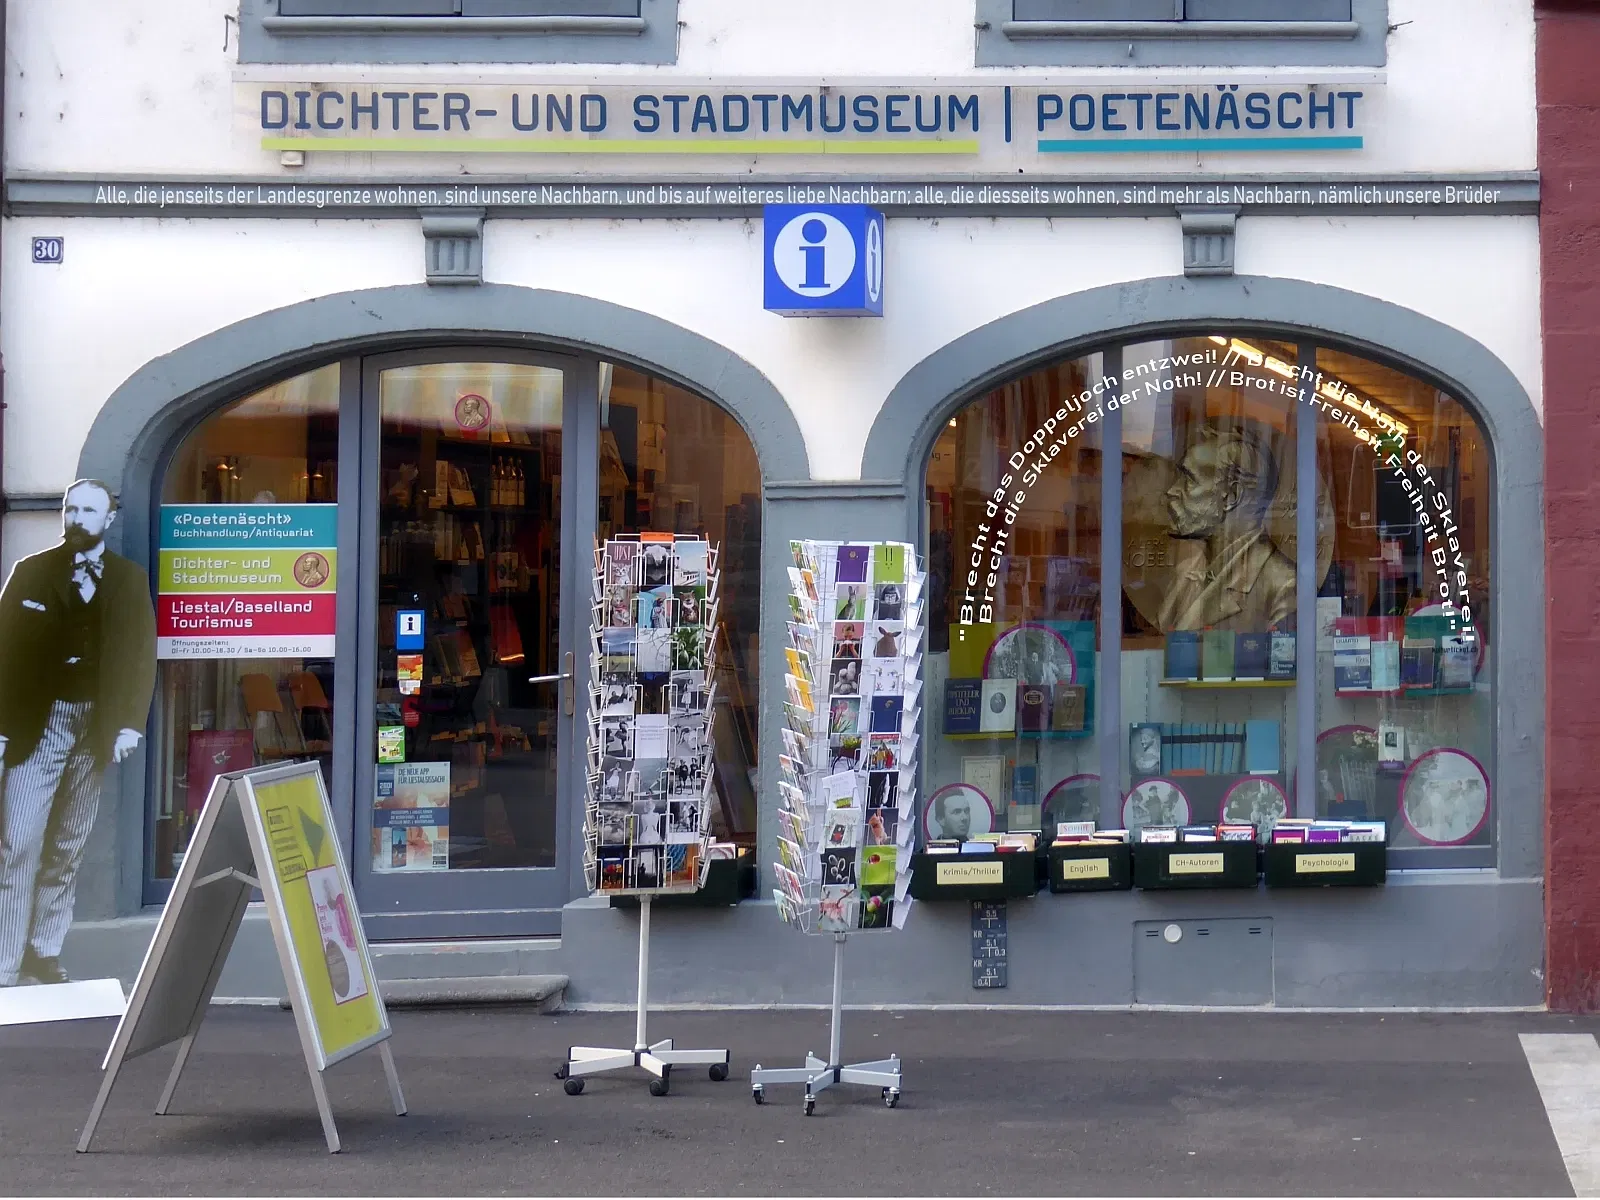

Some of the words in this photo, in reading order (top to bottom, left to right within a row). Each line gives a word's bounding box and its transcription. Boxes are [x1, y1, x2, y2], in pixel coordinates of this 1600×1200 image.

[261, 90, 498, 132] DICHTER-
[511, 93, 607, 133] UND
[632, 93, 979, 133] STADTMUSEUM
[1037, 84, 1364, 132] POETENÄSCHT
[95, 186, 130, 206] Alle,
[134, 186, 157, 204] die
[159, 186, 224, 208] jenseits
[227, 186, 255, 204] der
[257, 186, 371, 208] Landesgrenze
[374, 186, 441, 206] wohnen,
[445, 186, 478, 204] sind
[482, 190, 537, 204] unsere
[541, 186, 623, 206] Nachbarn,
[626, 186, 655, 204] und
[659, 186, 682, 204] bis
[686, 186, 711, 204] auf
[714, 186, 784, 204] weiteres
[787, 186, 826, 204] liebe
[914, 186, 947, 206] alle,
[951, 186, 975, 204] die
[978, 186, 1050, 204] diesseits
[1053, 186, 1120, 206] wohnen,
[1123, 186, 1156, 204] sind
[1160, 186, 1202, 204] mehr
[1206, 186, 1230, 204] als
[1233, 186, 1315, 206] Nachbarn,
[1318, 186, 1382, 204] nämlich
[1386, 190, 1441, 204] unsere
[1445, 186, 1501, 204] Brüder
[34, 238, 61, 261] 30
[978, 528, 1010, 624] Brecht
[1004, 489, 1027, 525] die
[1022, 405, 1105, 488] Sklaverei
[1107, 387, 1141, 411] der
[1144, 371, 1202, 396] Noth!
[1229, 371, 1276, 393] Brot
[1280, 380, 1305, 403] ist
[1308, 393, 1383, 457] Freiheit,
[1385, 452, 1440, 544] Freiheit
[986, 472, 1013, 518] das
[1009, 374, 1118, 471] Doppeljoch
[1122, 349, 1217, 381] entzwei!
[1326, 380, 1359, 406] die
[1360, 399, 1406, 449] Noth
[1406, 449, 1436, 488] der
[1432, 490, 1475, 642] Sklaverei!
[174, 513, 292, 525] «Poetenäscht»
[173, 528, 314, 539] Buchhandlung/Antiquariat
[173, 557, 237, 569] Dichter-
[242, 557, 271, 568] und
[172, 572, 282, 584] Stadtmuseum
[172, 598, 313, 614] Liestal/Baselland
[171, 616, 253, 629] Tourismus
[1175, 858, 1220, 866] CH-Autoren
[1302, 859, 1350, 868] Psychologie
[943, 867, 1000, 877] Krimis/Thriller
[1070, 864, 1099, 874] English
[973, 930, 983, 938] KR
[973, 960, 983, 968] KR
